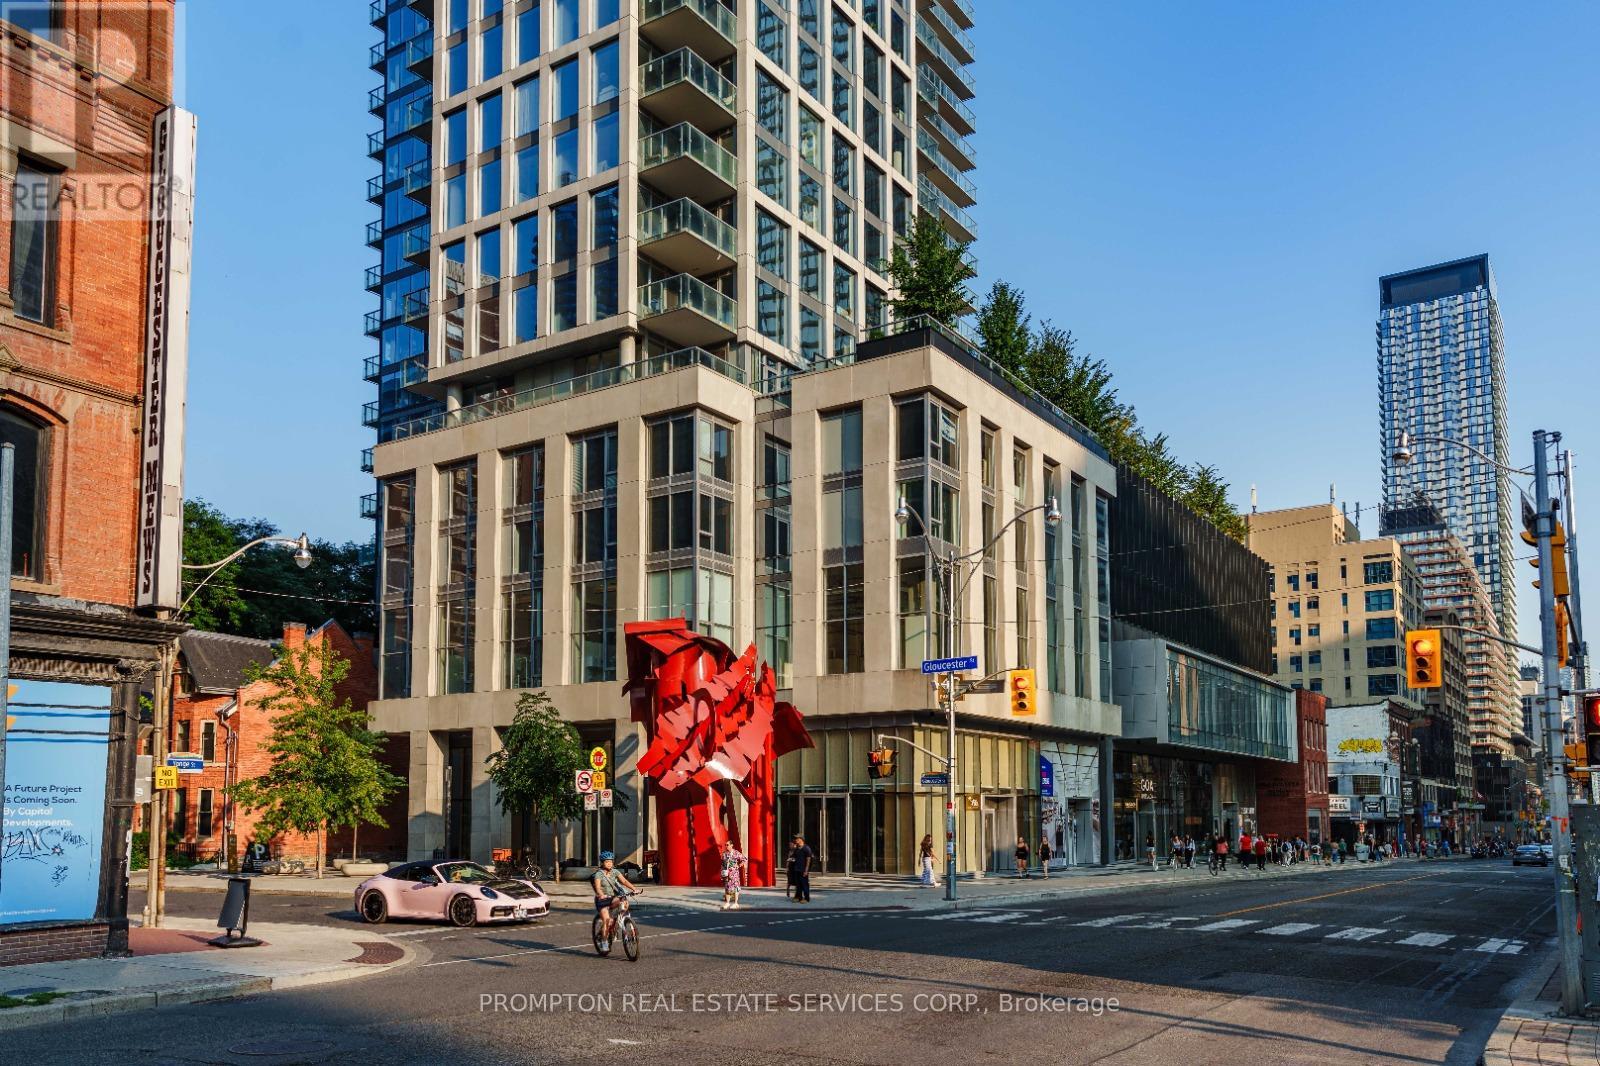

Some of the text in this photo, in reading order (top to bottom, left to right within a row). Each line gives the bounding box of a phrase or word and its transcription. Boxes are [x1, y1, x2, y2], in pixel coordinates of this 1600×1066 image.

[143, 119, 168, 595] GLOUCESTER MEWS
[923, 659, 967, 672] Gloucester
[161, 769, 173, 777] NO
[158, 778, 174, 787] EXIT
[1140, 779, 1154, 792] GOA
[4, 784, 82, 796] A Future Project
[13, 795, 50, 807] Coming
[51, 796, 78, 804] Soon.
[3, 807, 54, 817] By Capital
[2, 818, 74, 827] Developments.
[254, 843, 266, 859] P
